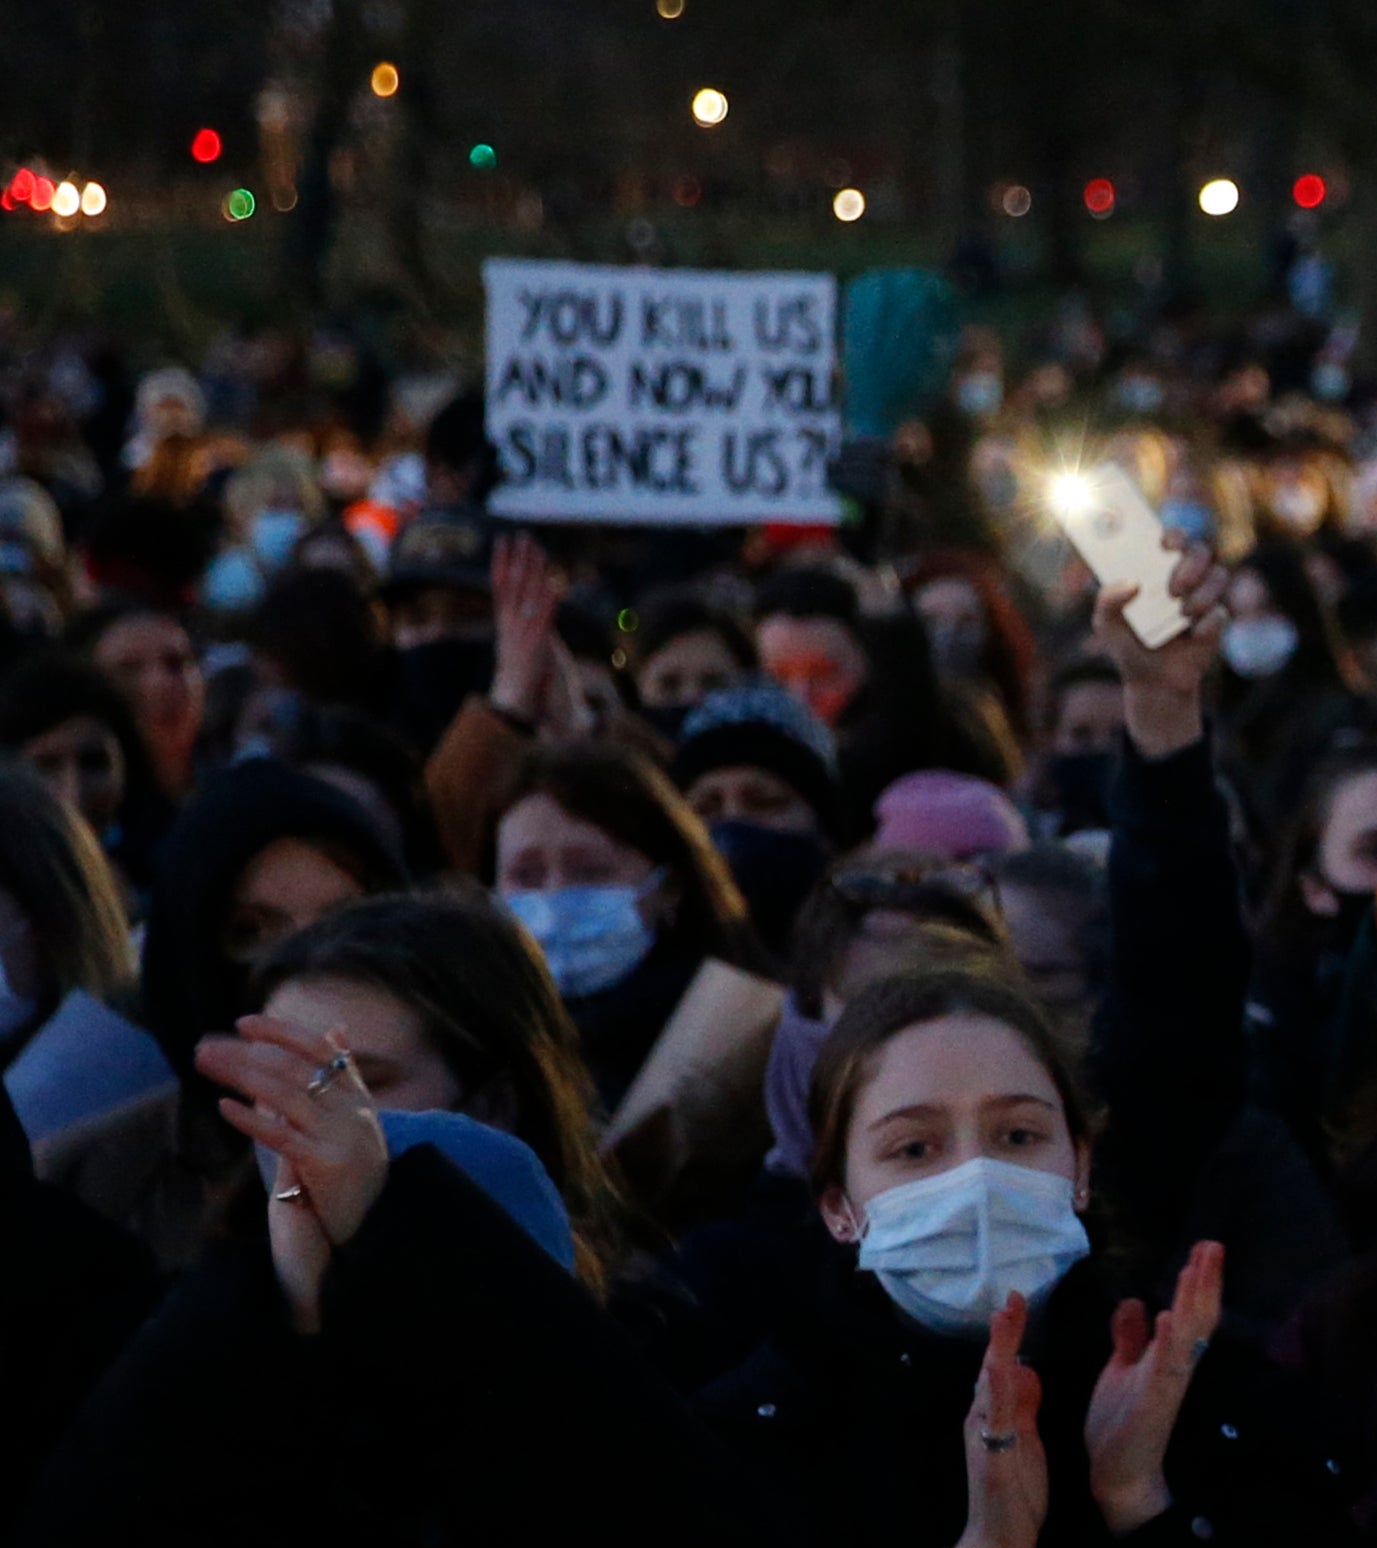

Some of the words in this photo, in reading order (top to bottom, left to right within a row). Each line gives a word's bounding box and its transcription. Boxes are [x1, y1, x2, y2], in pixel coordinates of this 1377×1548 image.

[519, 286, 624, 346] YOU
[639, 293, 731, 350] KILL
[752, 293, 823, 354] US
[501, 355, 607, 407] AND
[628, 358, 746, 411] NOW
[505, 422, 700, 494] SILENCE
